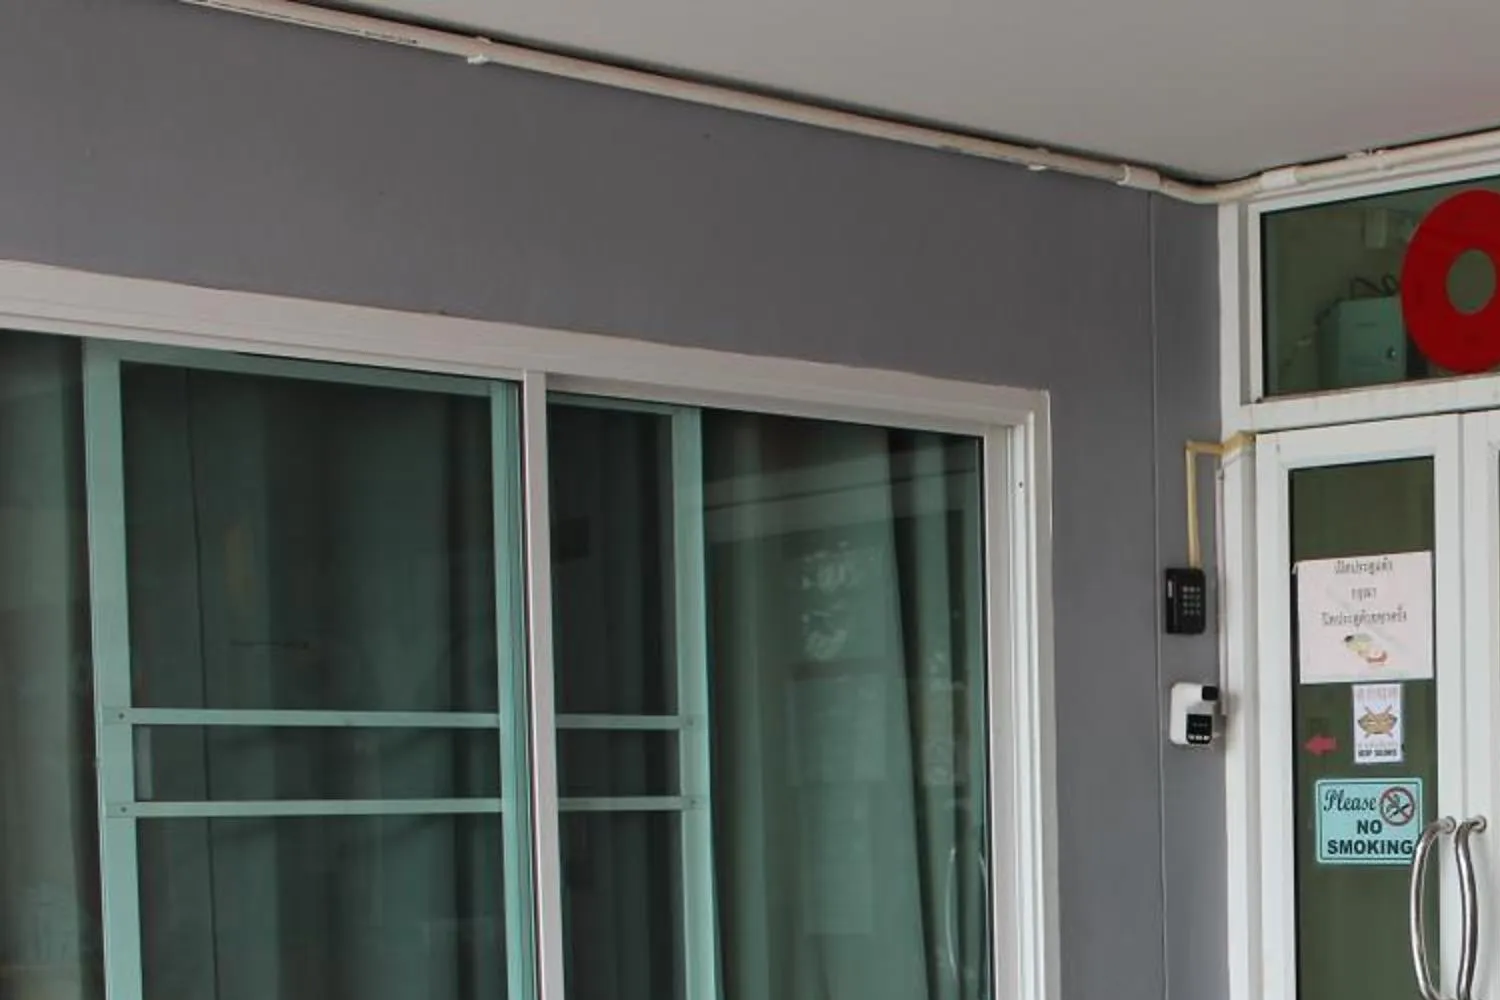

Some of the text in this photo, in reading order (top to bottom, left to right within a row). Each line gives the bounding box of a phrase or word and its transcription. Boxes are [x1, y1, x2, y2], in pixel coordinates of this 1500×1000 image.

[1323, 789, 1377, 812] Please
[1357, 819, 1383, 834] NO
[1327, 839, 1413, 855] SMOKING
